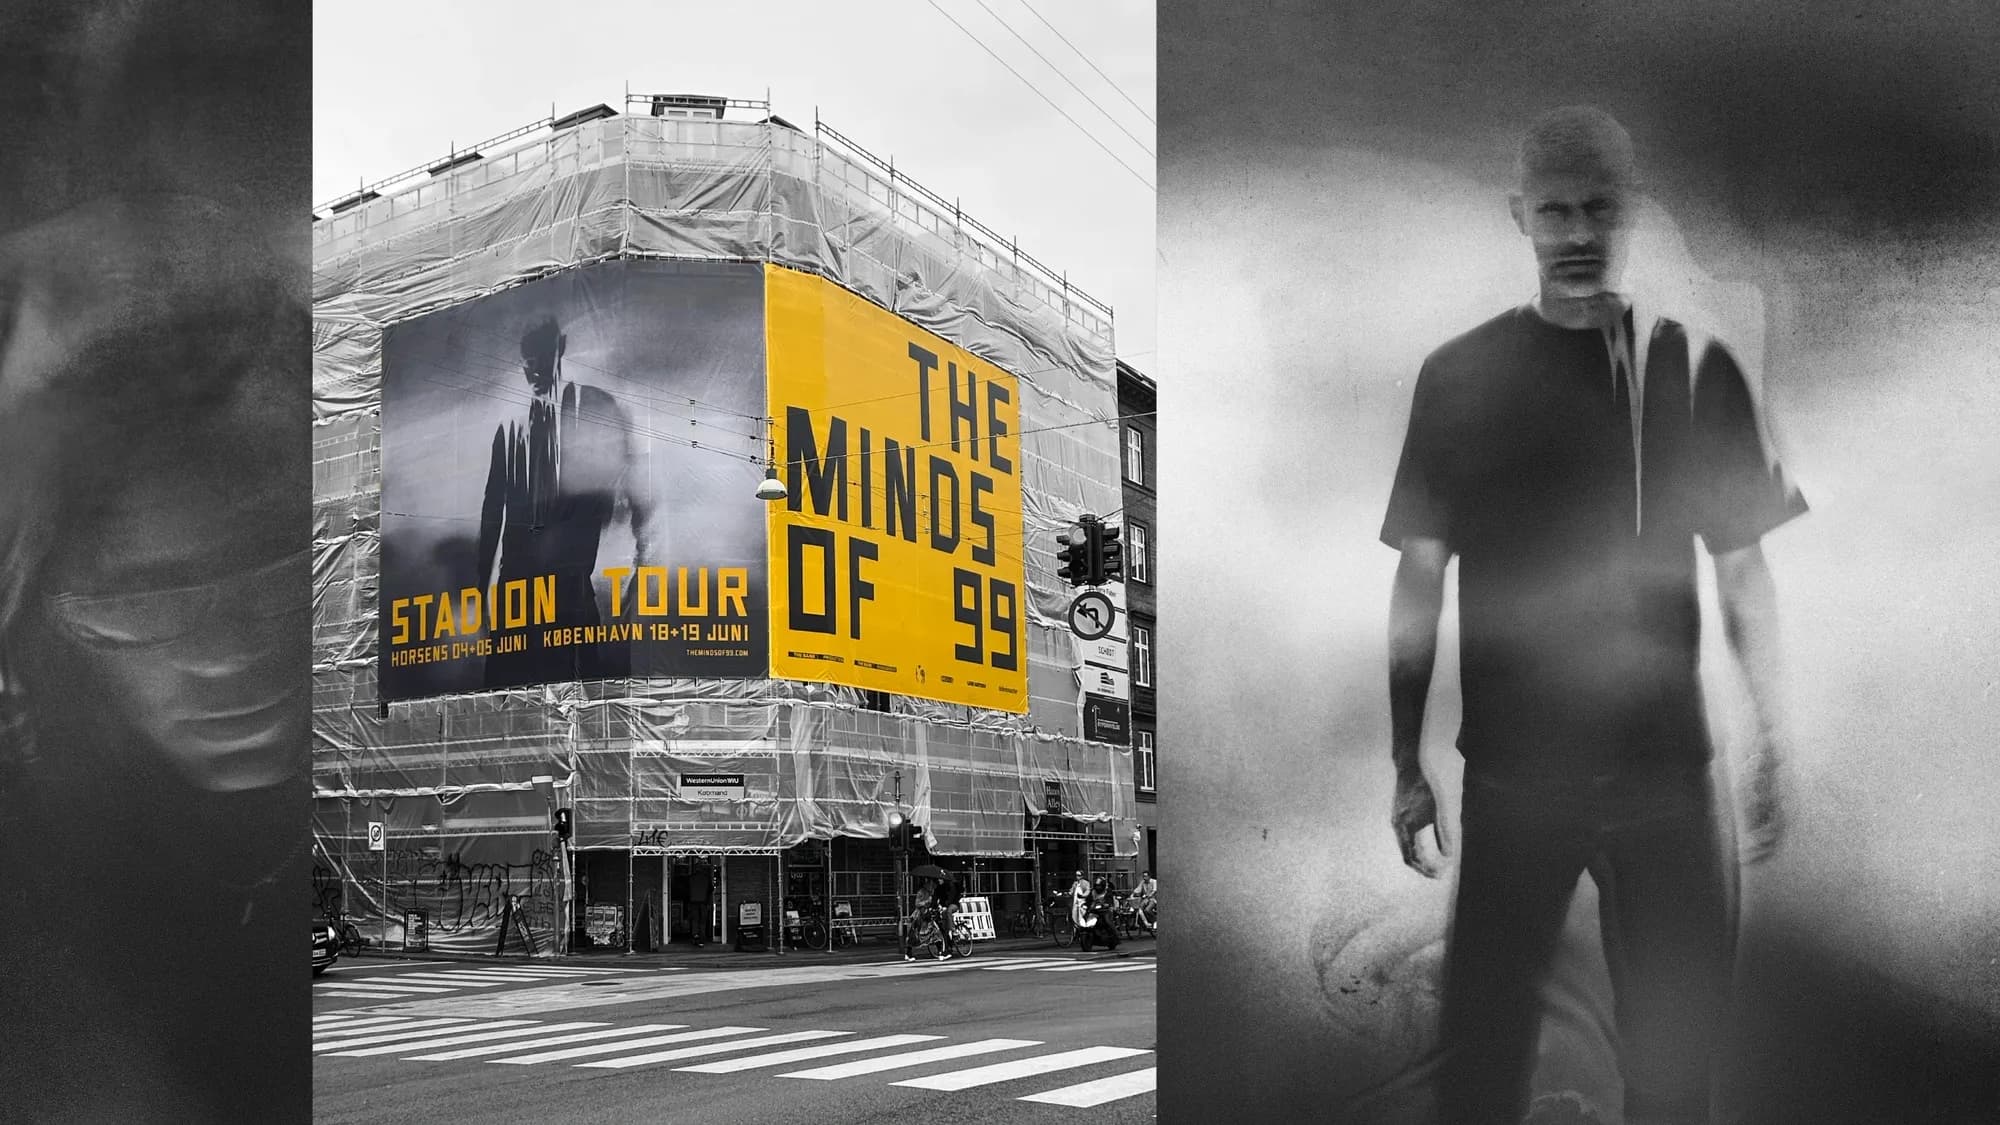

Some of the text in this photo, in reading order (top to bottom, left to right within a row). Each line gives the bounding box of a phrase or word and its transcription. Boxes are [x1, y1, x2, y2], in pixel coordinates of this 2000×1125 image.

[909, 341, 1011, 475] THE
[787, 406, 995, 567] MINDS
[391, 567, 748, 645] STADION TOUR
[391, 634, 527, 667] HORSENS 04+05 JUNI
[543, 623, 748, 648] KØBENHAVN 18+19 JUNI
[788, 524, 1017, 672] OF 99
